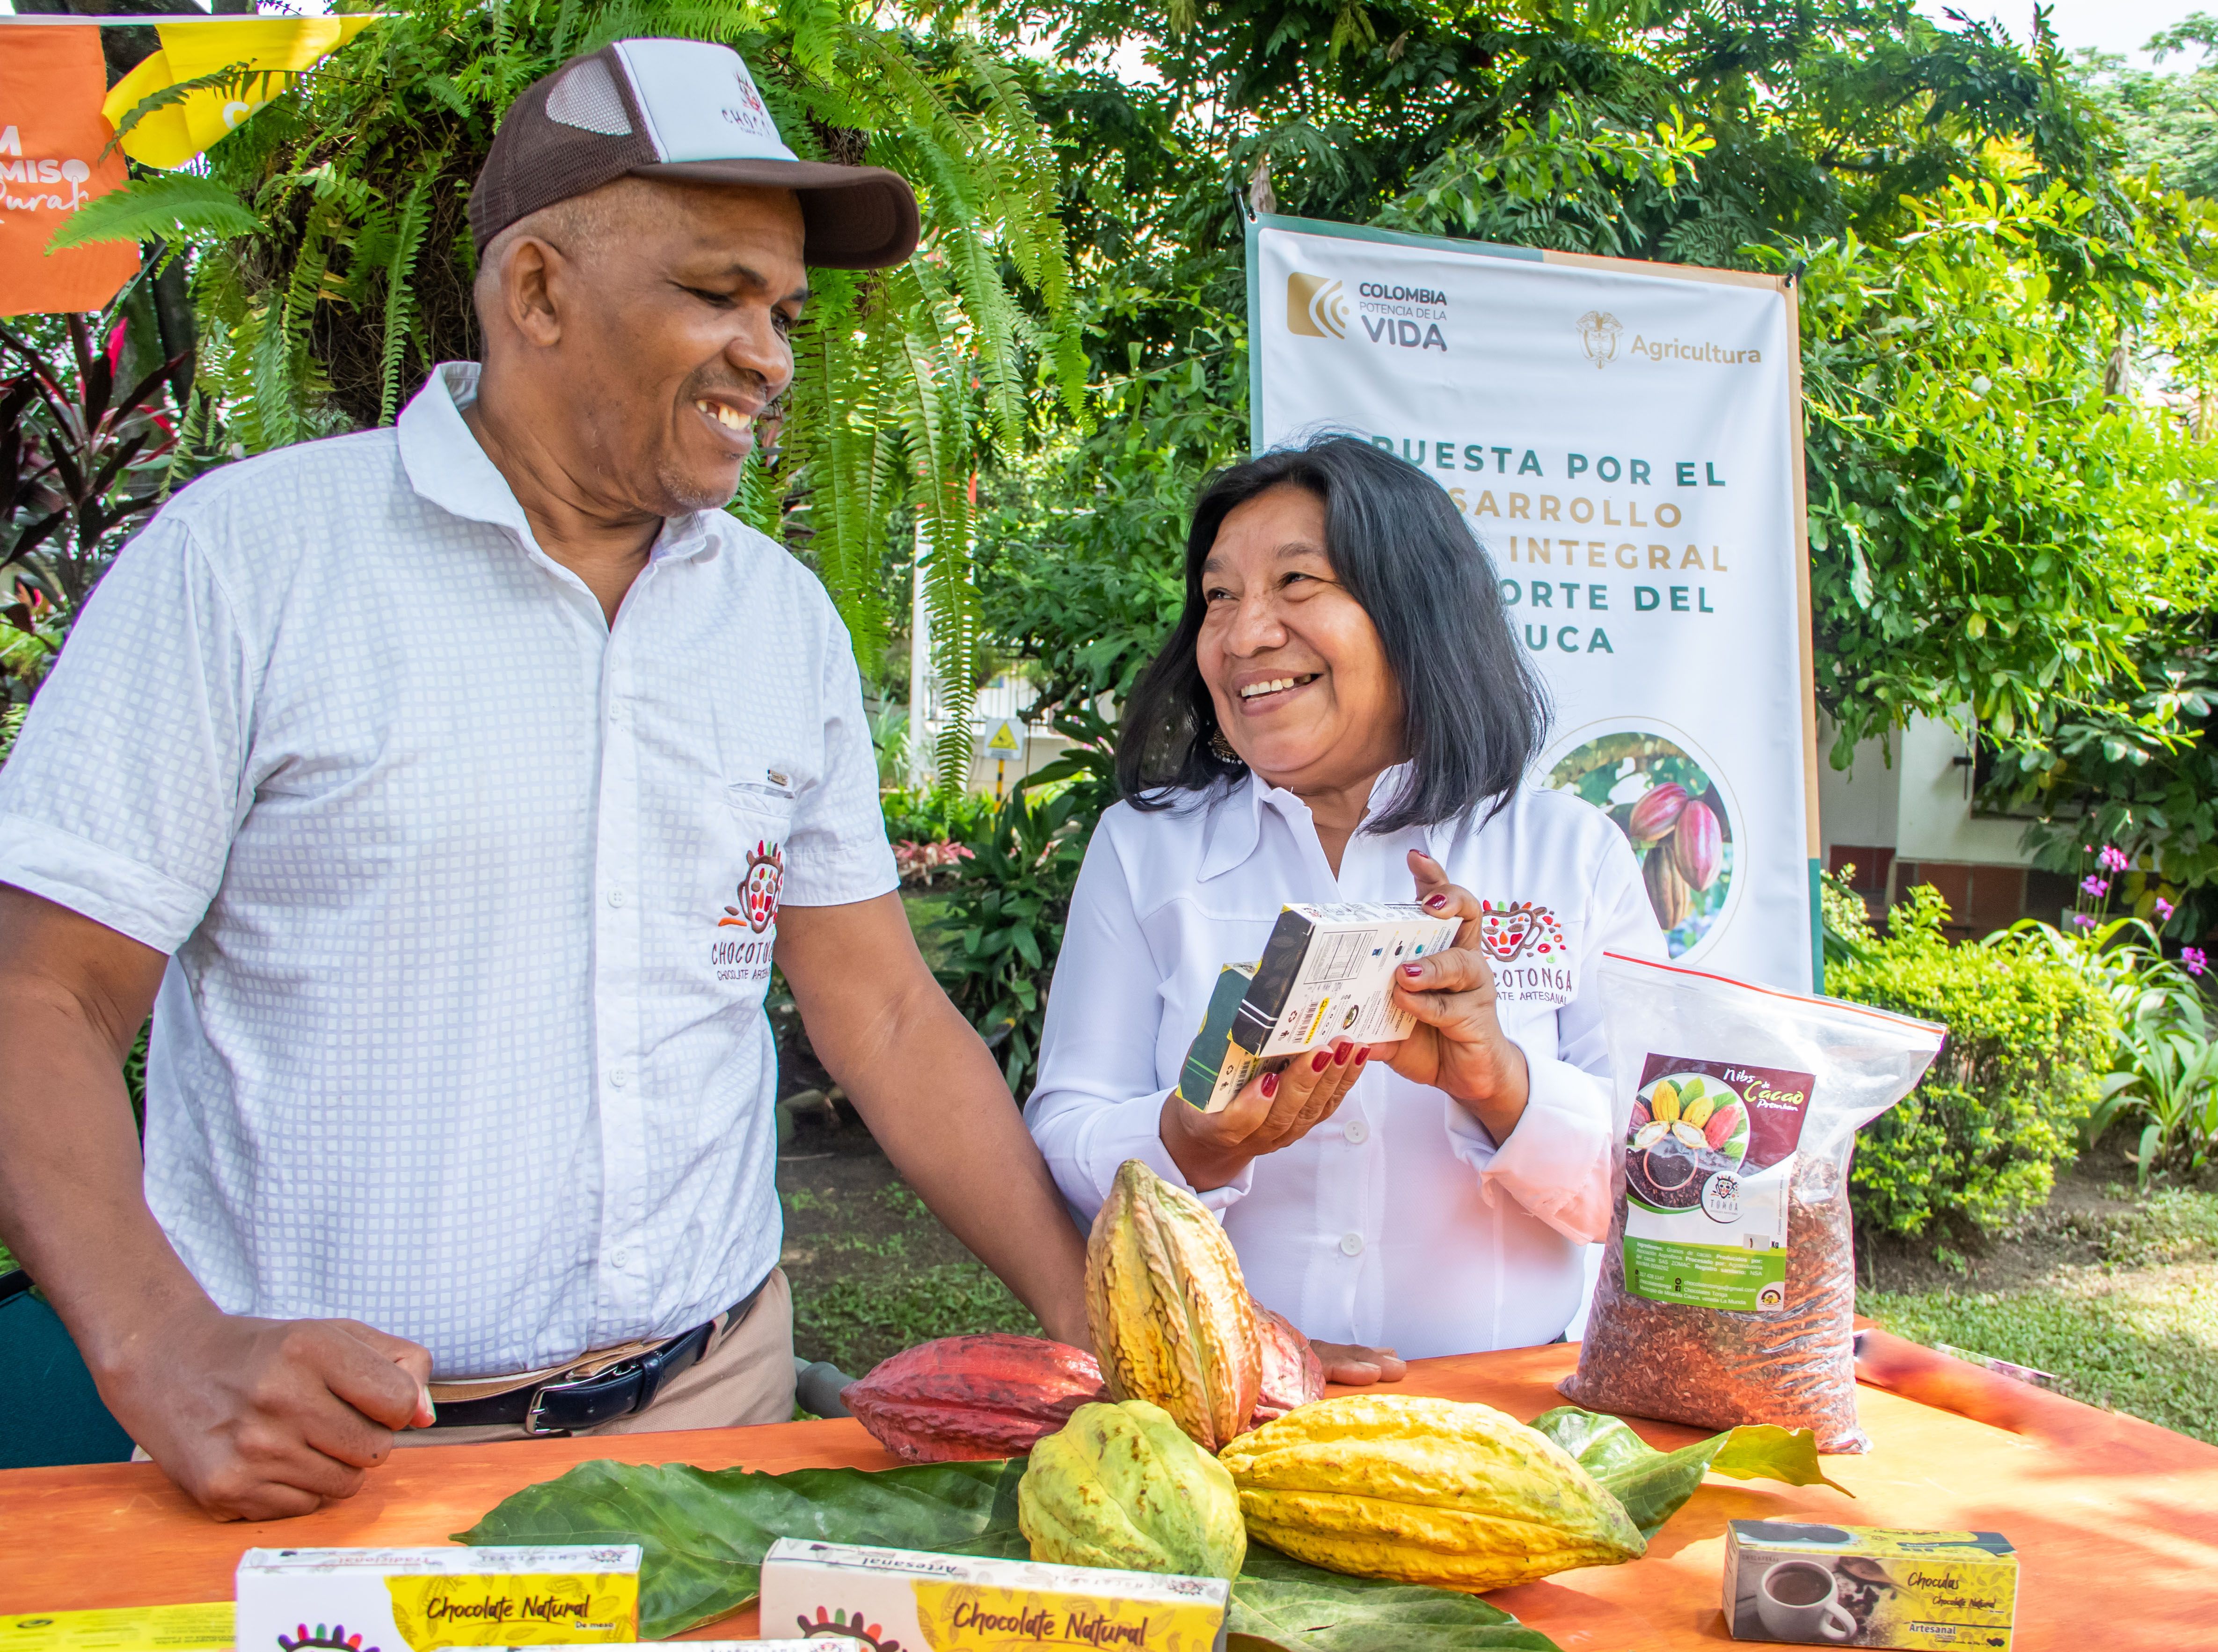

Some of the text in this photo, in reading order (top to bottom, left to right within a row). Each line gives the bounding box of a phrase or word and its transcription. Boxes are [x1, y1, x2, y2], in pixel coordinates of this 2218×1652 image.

[1359, 283, 1447, 306] COLOMBIA
[1359, 301, 1447, 321] POTENCIA DE LA
[1361, 314, 1448, 352] VIDA
[1630, 335, 1761, 364] Agricultura
[1568, 453, 1651, 486] POR
[1676, 462, 1726, 487] EL
[1510, 535, 1729, 573] INTEGRAL
[1634, 586, 1714, 614] DEL
[1525, 624, 1614, 654] UCA
[1520, 991, 1566, 1006] ARTESANAL
[1723, 1068, 1756, 1083] Nibs
[1743, 1080, 1804, 1105] Cacao
[1771, 1241, 1779, 1249] Kg
[1685, 1256, 1713, 1265] Procesado
[1716, 1254, 1747, 1262] Producidos
[862, 1557, 957, 1573] Artesanal
[427, 1594, 591, 1623] Chocolate Natural
[953, 1601, 1149, 1647] Chocolate Natural
[1909, 1623, 1956, 1634] Artesanal
